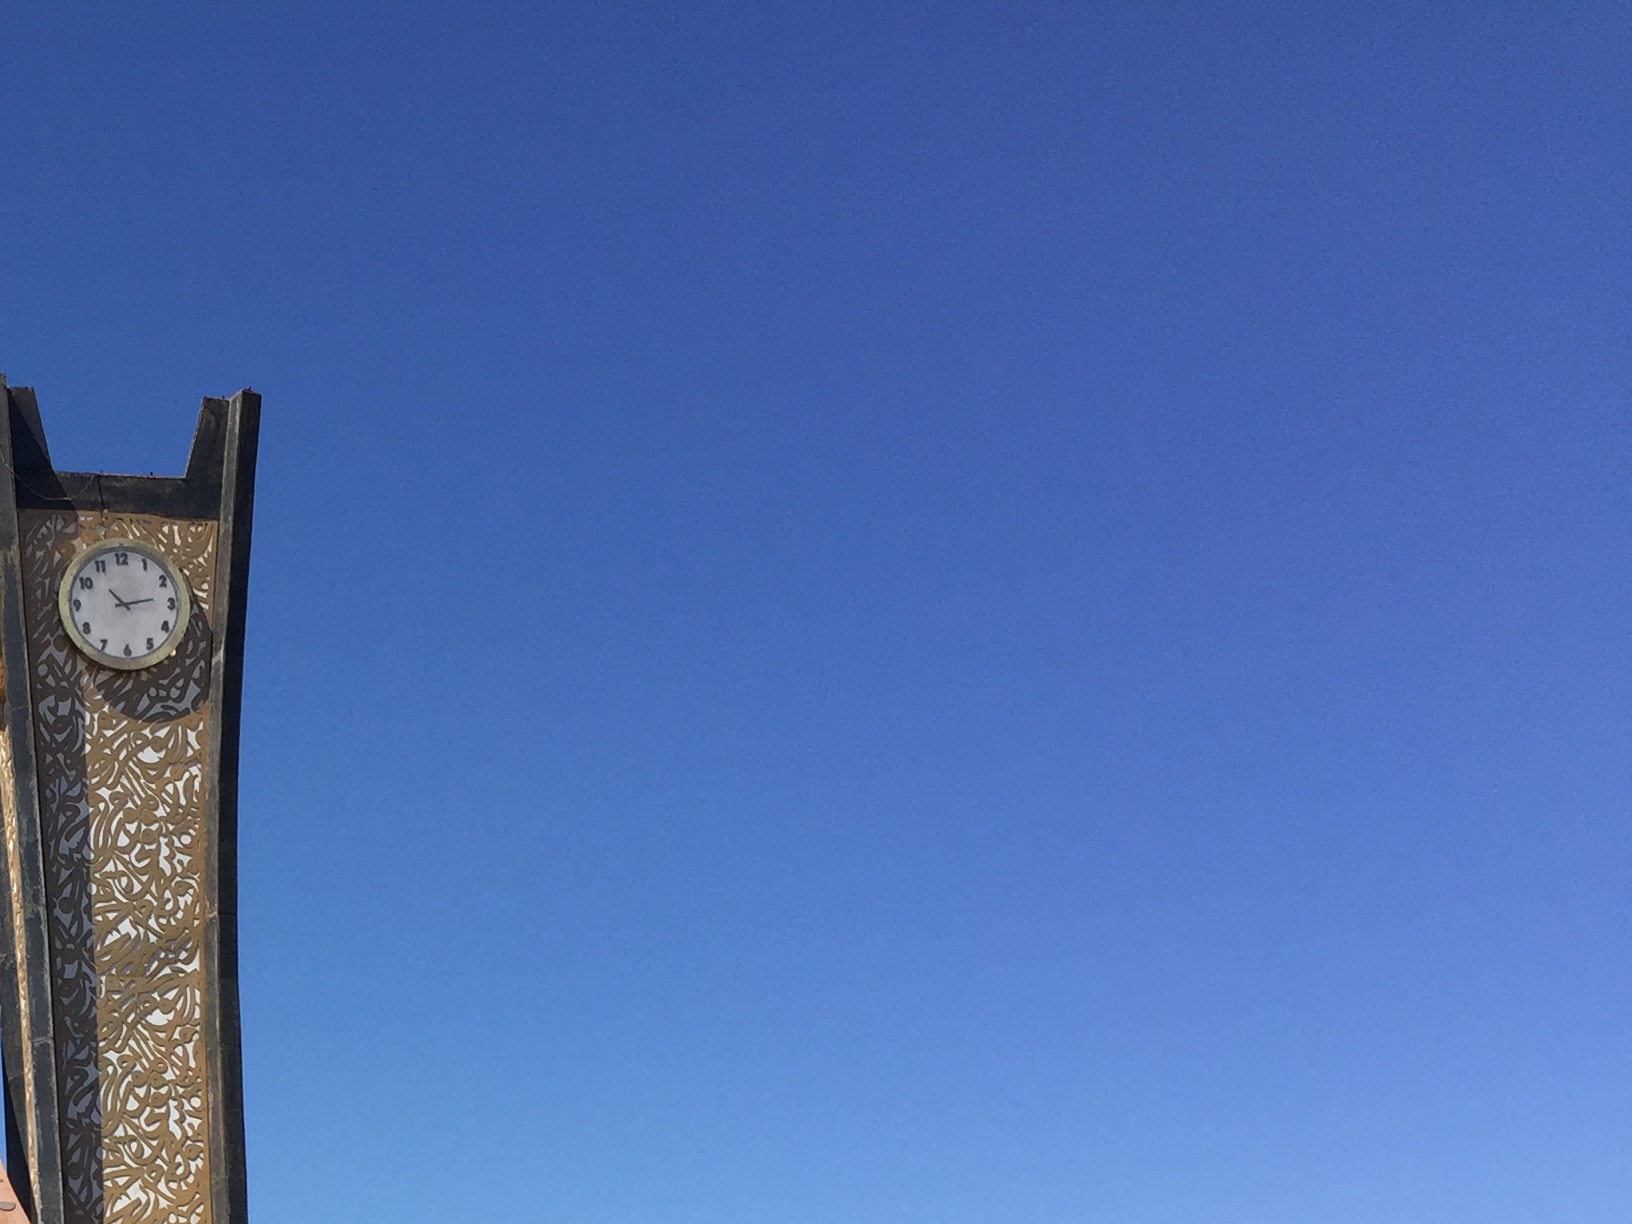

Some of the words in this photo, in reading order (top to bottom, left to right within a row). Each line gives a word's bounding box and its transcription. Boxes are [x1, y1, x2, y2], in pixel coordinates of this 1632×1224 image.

[114, 553, 128, 566] 12
[142, 558, 148, 572] 1
[94, 560, 106, 573] 11
[79, 577, 93, 590] 10
[159, 574, 167, 587] 2
[73, 599, 81, 612] 9
[167, 597, 176, 610] 3
[82, 621, 91, 634] 8
[160, 620, 169, 633] 4
[100, 639, 108, 651] 7
[123, 644, 132, 656] 6
[146, 637, 154, 650] 5
